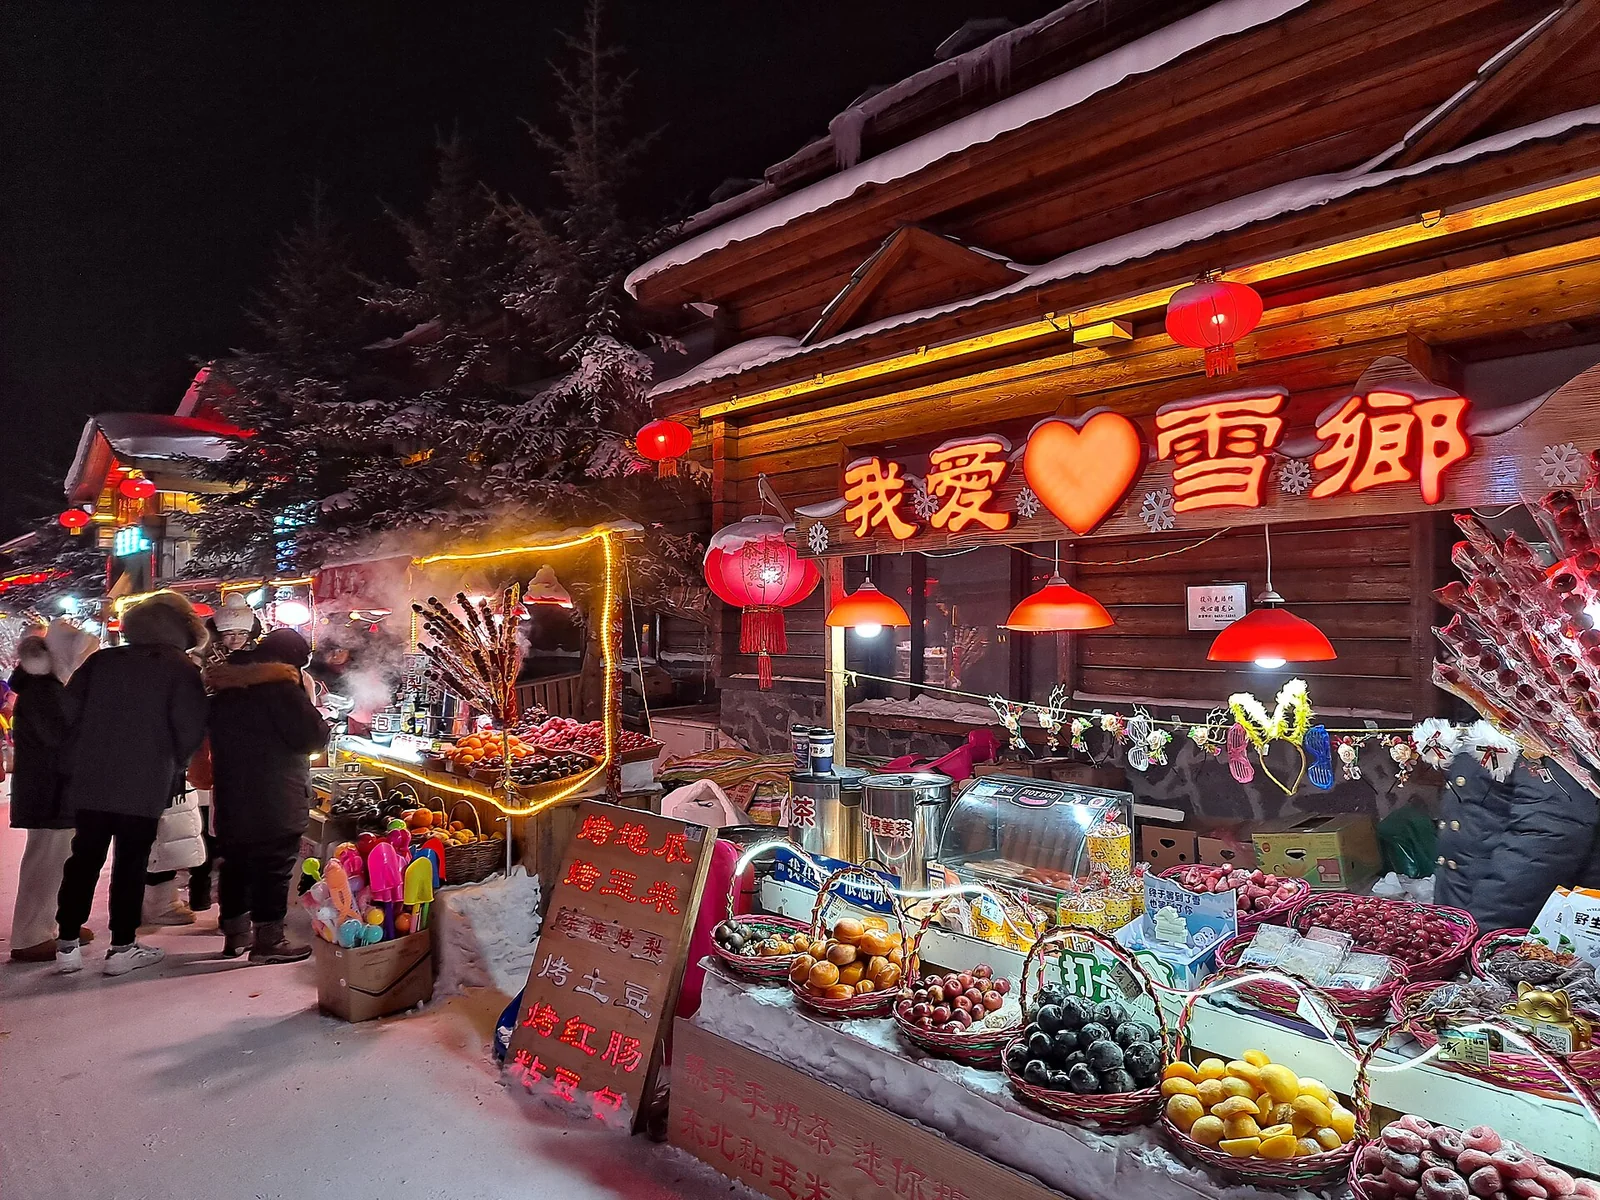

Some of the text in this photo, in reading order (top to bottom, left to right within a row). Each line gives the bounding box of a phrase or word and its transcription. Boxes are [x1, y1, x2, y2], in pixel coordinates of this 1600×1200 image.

[844, 442, 1011, 540] 我愛
[576, 813, 692, 865] 烤地瓜
[792, 796, 815, 827] 茶
[563, 859, 680, 915] 烤玉米
[537, 953, 652, 1019] 烤土豆
[523, 1001, 643, 1072] 烤红肠
